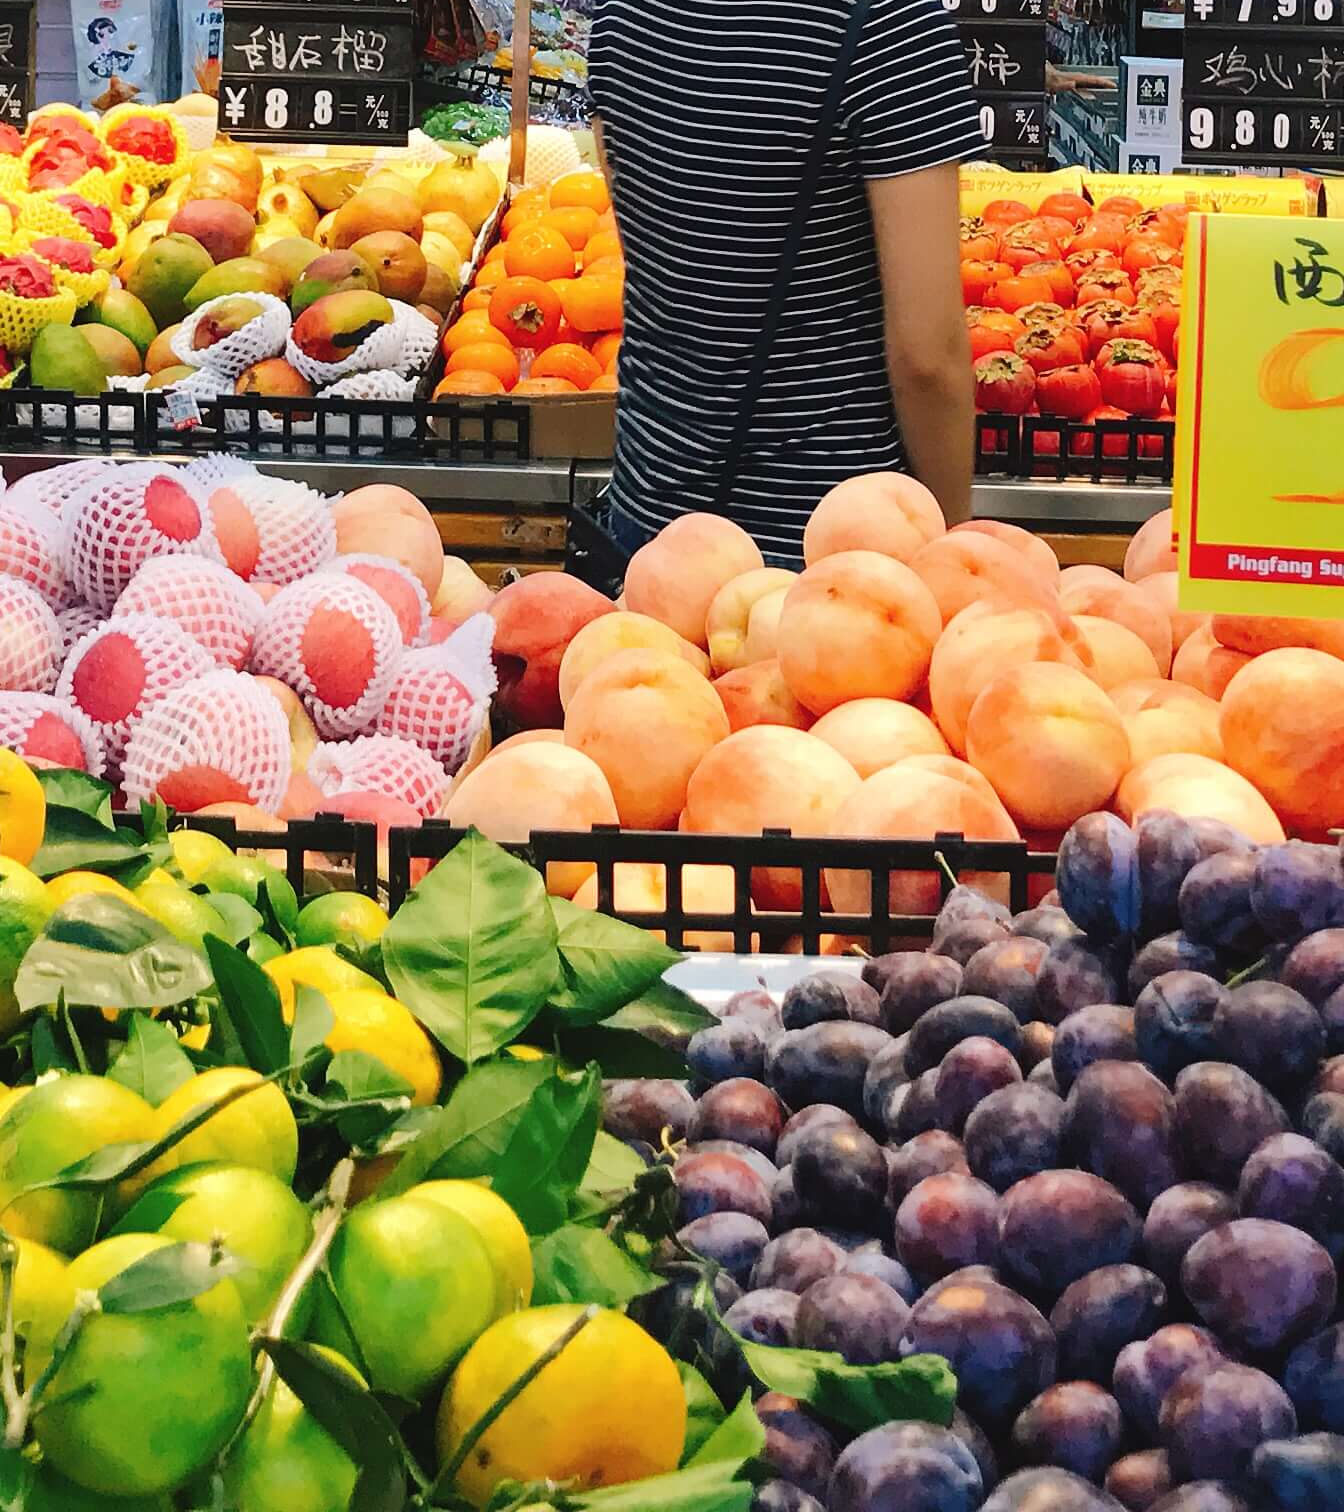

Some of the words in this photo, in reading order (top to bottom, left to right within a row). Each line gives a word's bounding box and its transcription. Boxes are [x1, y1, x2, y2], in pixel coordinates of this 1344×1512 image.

[232, 24, 387, 74] 甜石榴
[1140, 78, 1165, 98] 金典
[1189, 108, 1289, 150] 9.80
[1227, 552, 1314, 580] Pingfang
